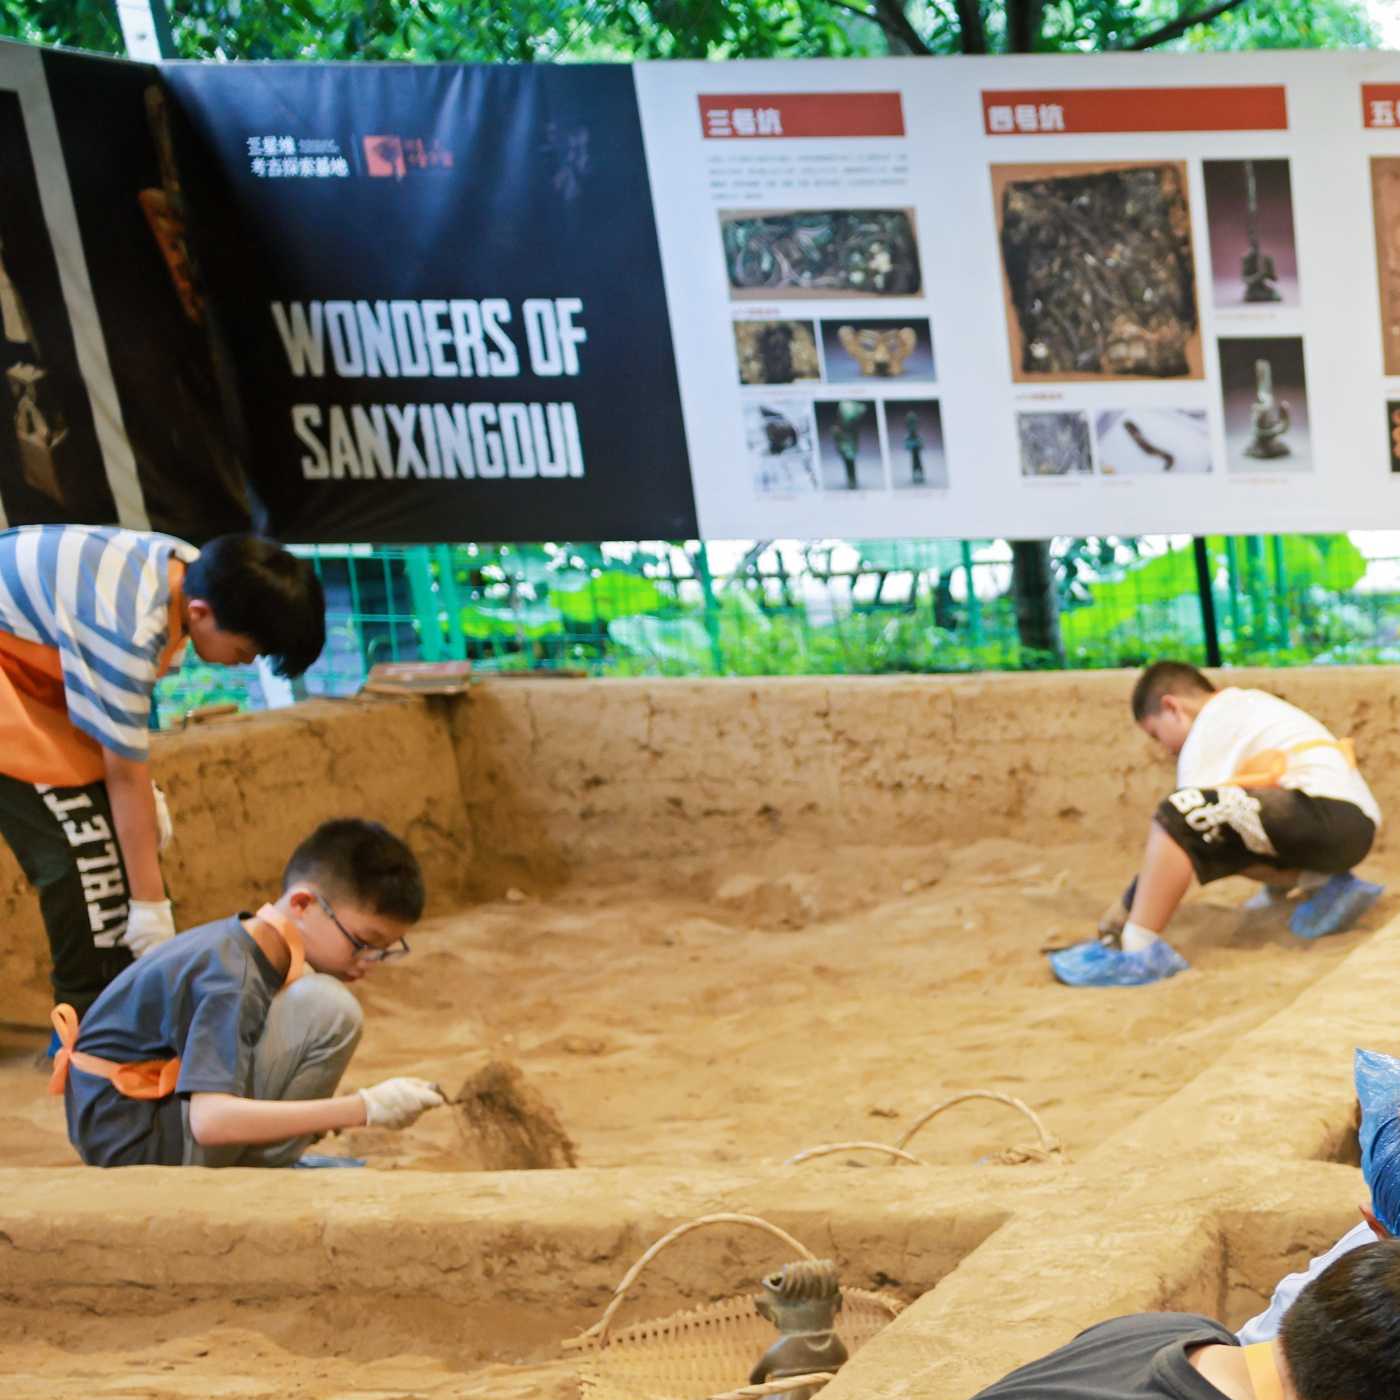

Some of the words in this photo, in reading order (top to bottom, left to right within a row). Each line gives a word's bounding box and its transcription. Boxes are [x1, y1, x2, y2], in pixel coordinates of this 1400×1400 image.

[706, 108, 784, 136] 三号坑
[272, 298, 519, 379] WONDERS
[523, 298, 587, 377] OF
[292, 401, 585, 480] SANXINGDUI
